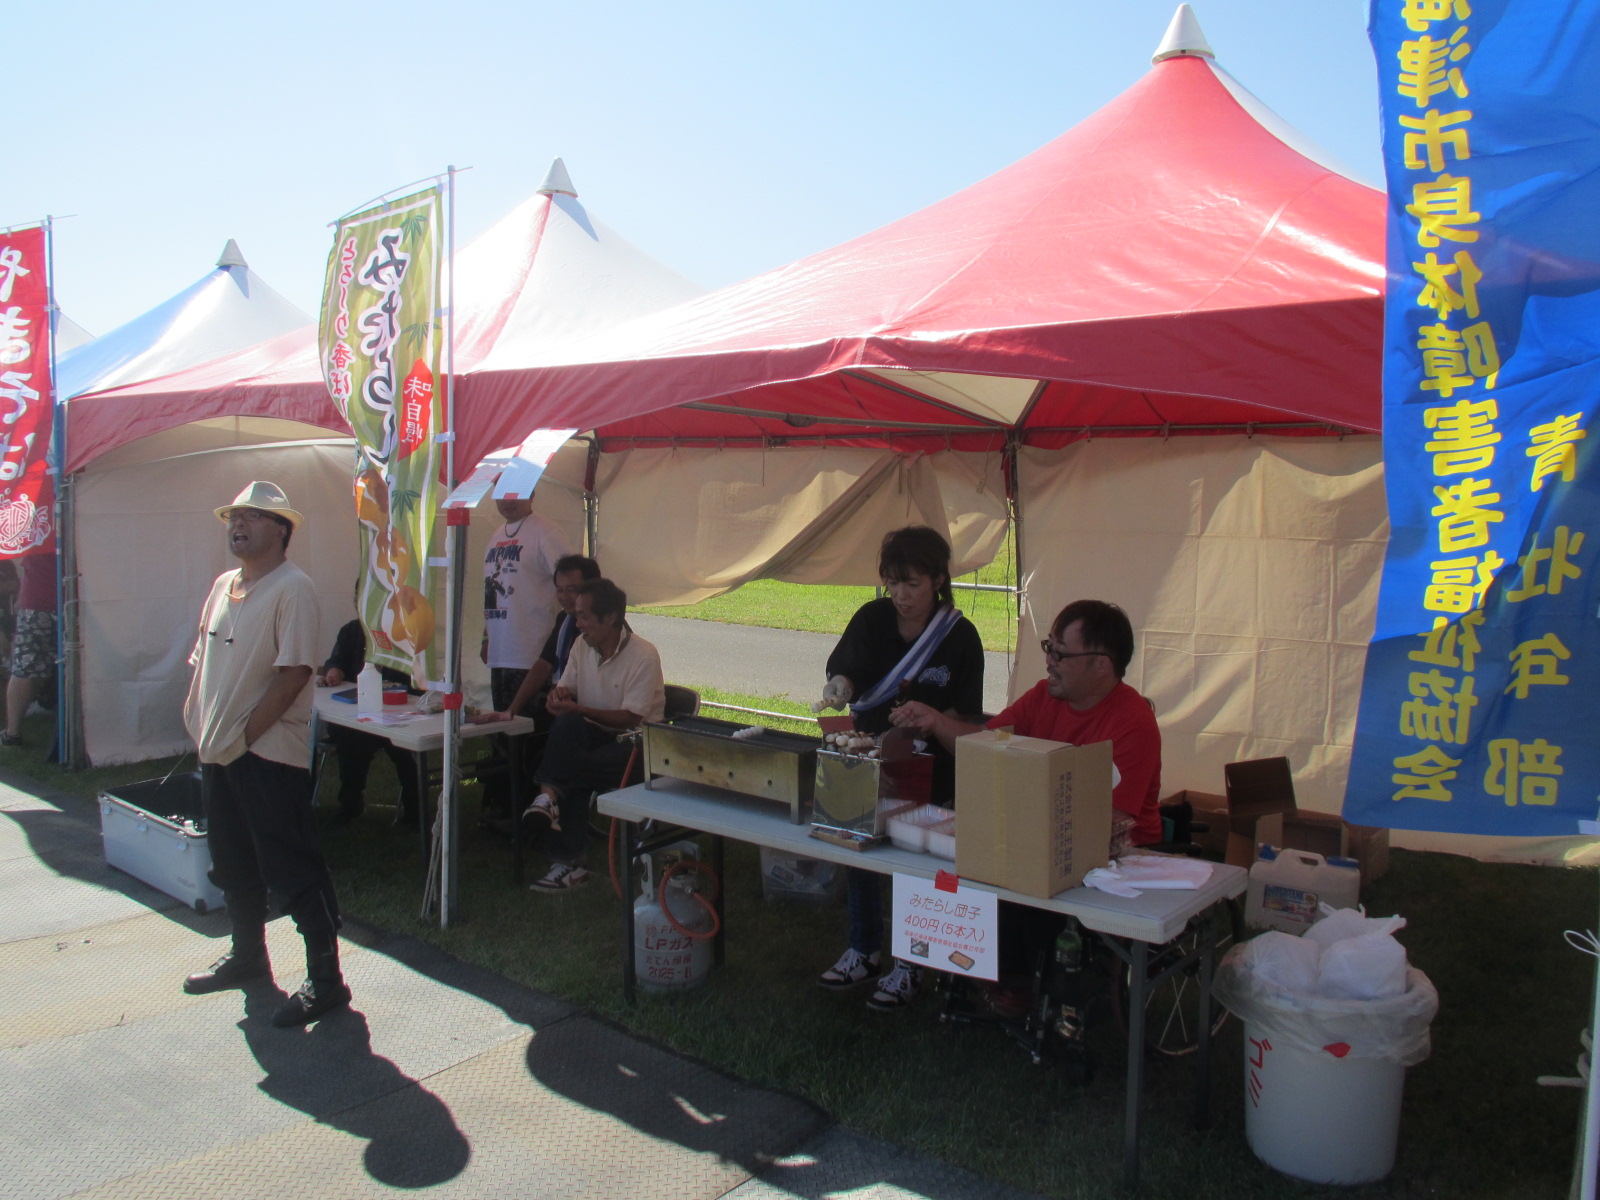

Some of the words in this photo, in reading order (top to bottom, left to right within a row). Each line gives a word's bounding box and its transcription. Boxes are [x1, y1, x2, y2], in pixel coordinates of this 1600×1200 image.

[909, 893, 982, 921] みたらし団子
[1248, 1036, 1273, 1108] ゴミ
